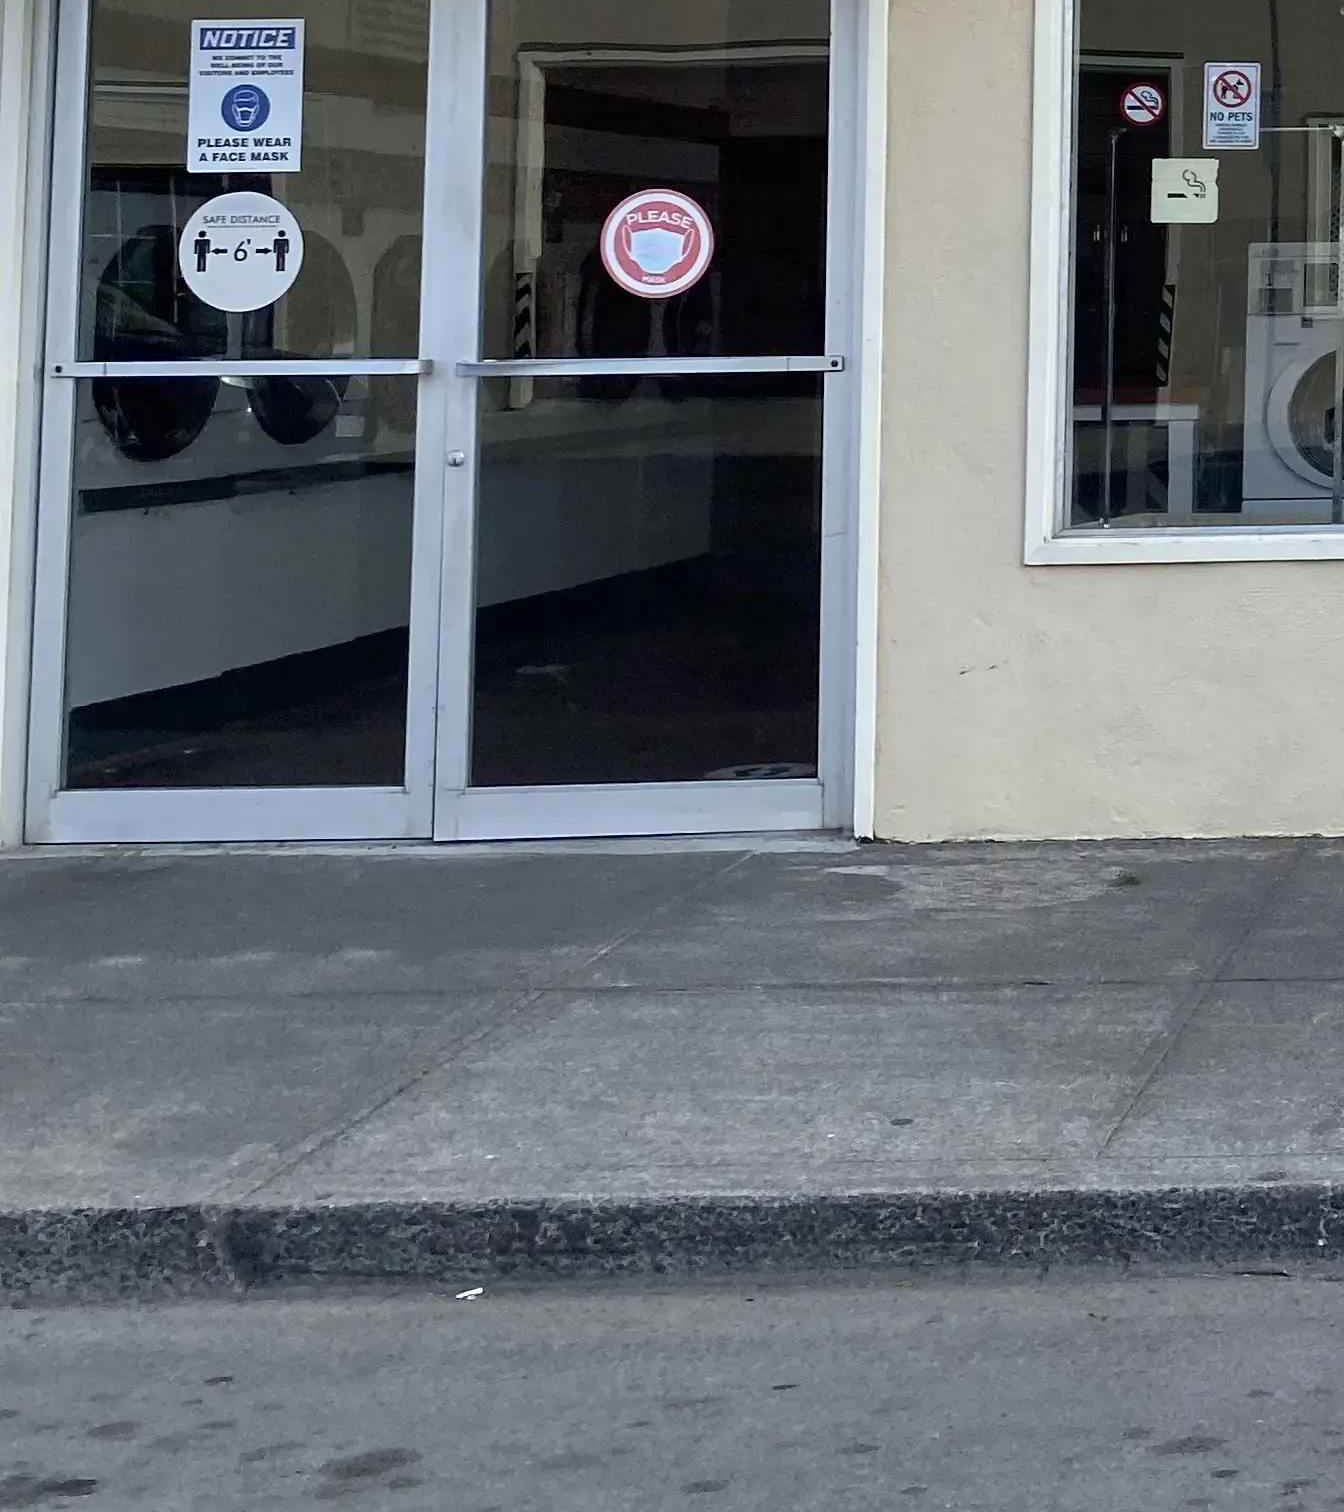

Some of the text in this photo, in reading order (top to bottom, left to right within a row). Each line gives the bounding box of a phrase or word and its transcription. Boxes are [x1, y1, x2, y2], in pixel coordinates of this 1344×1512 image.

[202, 29, 293, 48] NOTICE
[1209, 112, 1254, 122] NO PETS
[197, 137, 292, 148] PLEASE WEAR
[199, 151, 290, 162] A FACE MASK
[203, 215, 281, 224] SAFE DISTANCE
[625, 210, 695, 229] PLEASE
